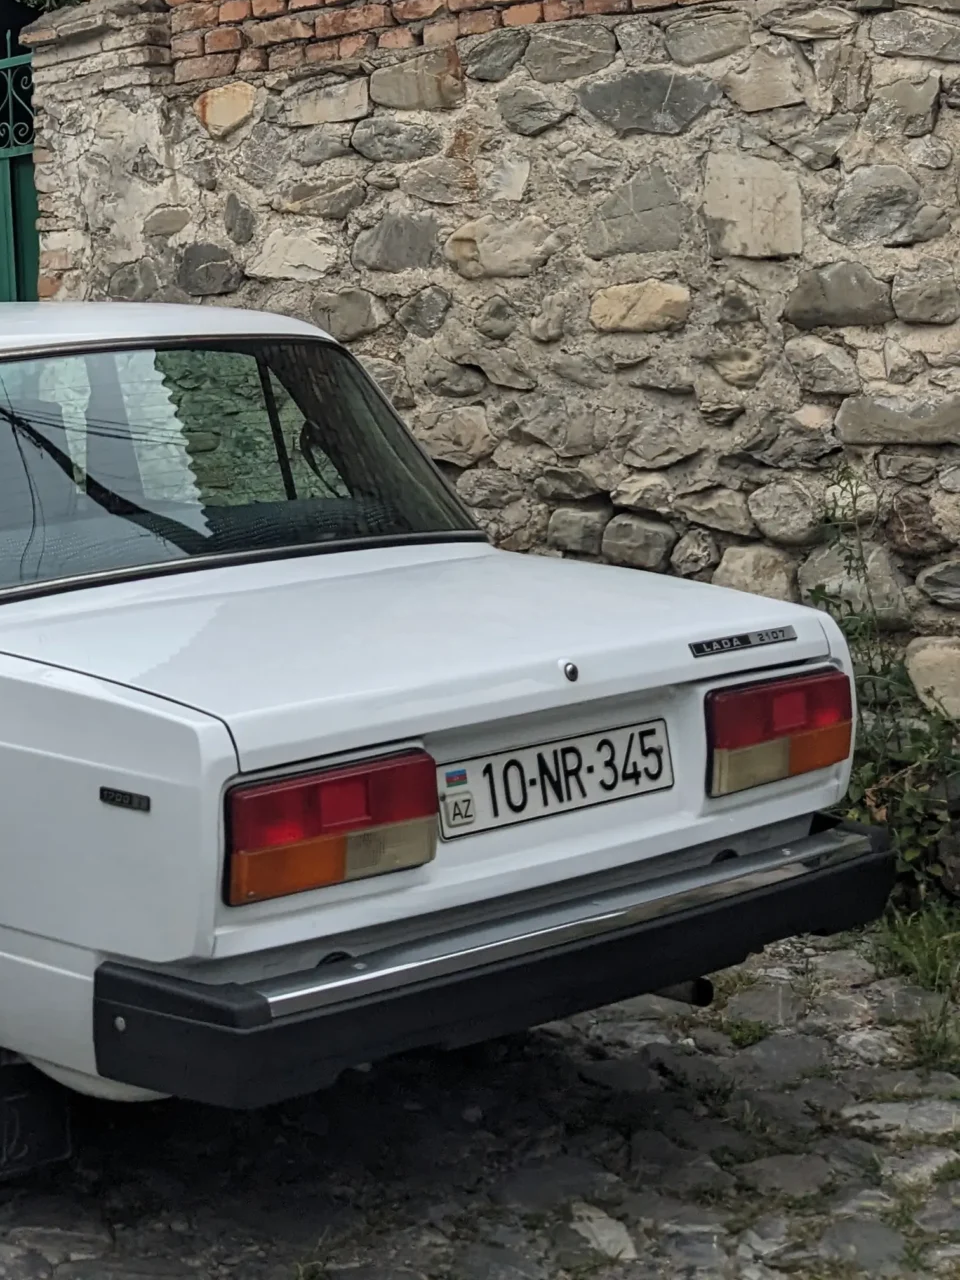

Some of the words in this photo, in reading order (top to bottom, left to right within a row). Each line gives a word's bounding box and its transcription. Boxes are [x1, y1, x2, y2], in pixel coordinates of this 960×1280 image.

[702, 637, 742, 652] LADA
[757, 629, 786, 642] 2107
[482, 727, 664, 818] 10-NR-345
[451, 799, 474, 822] AZ
